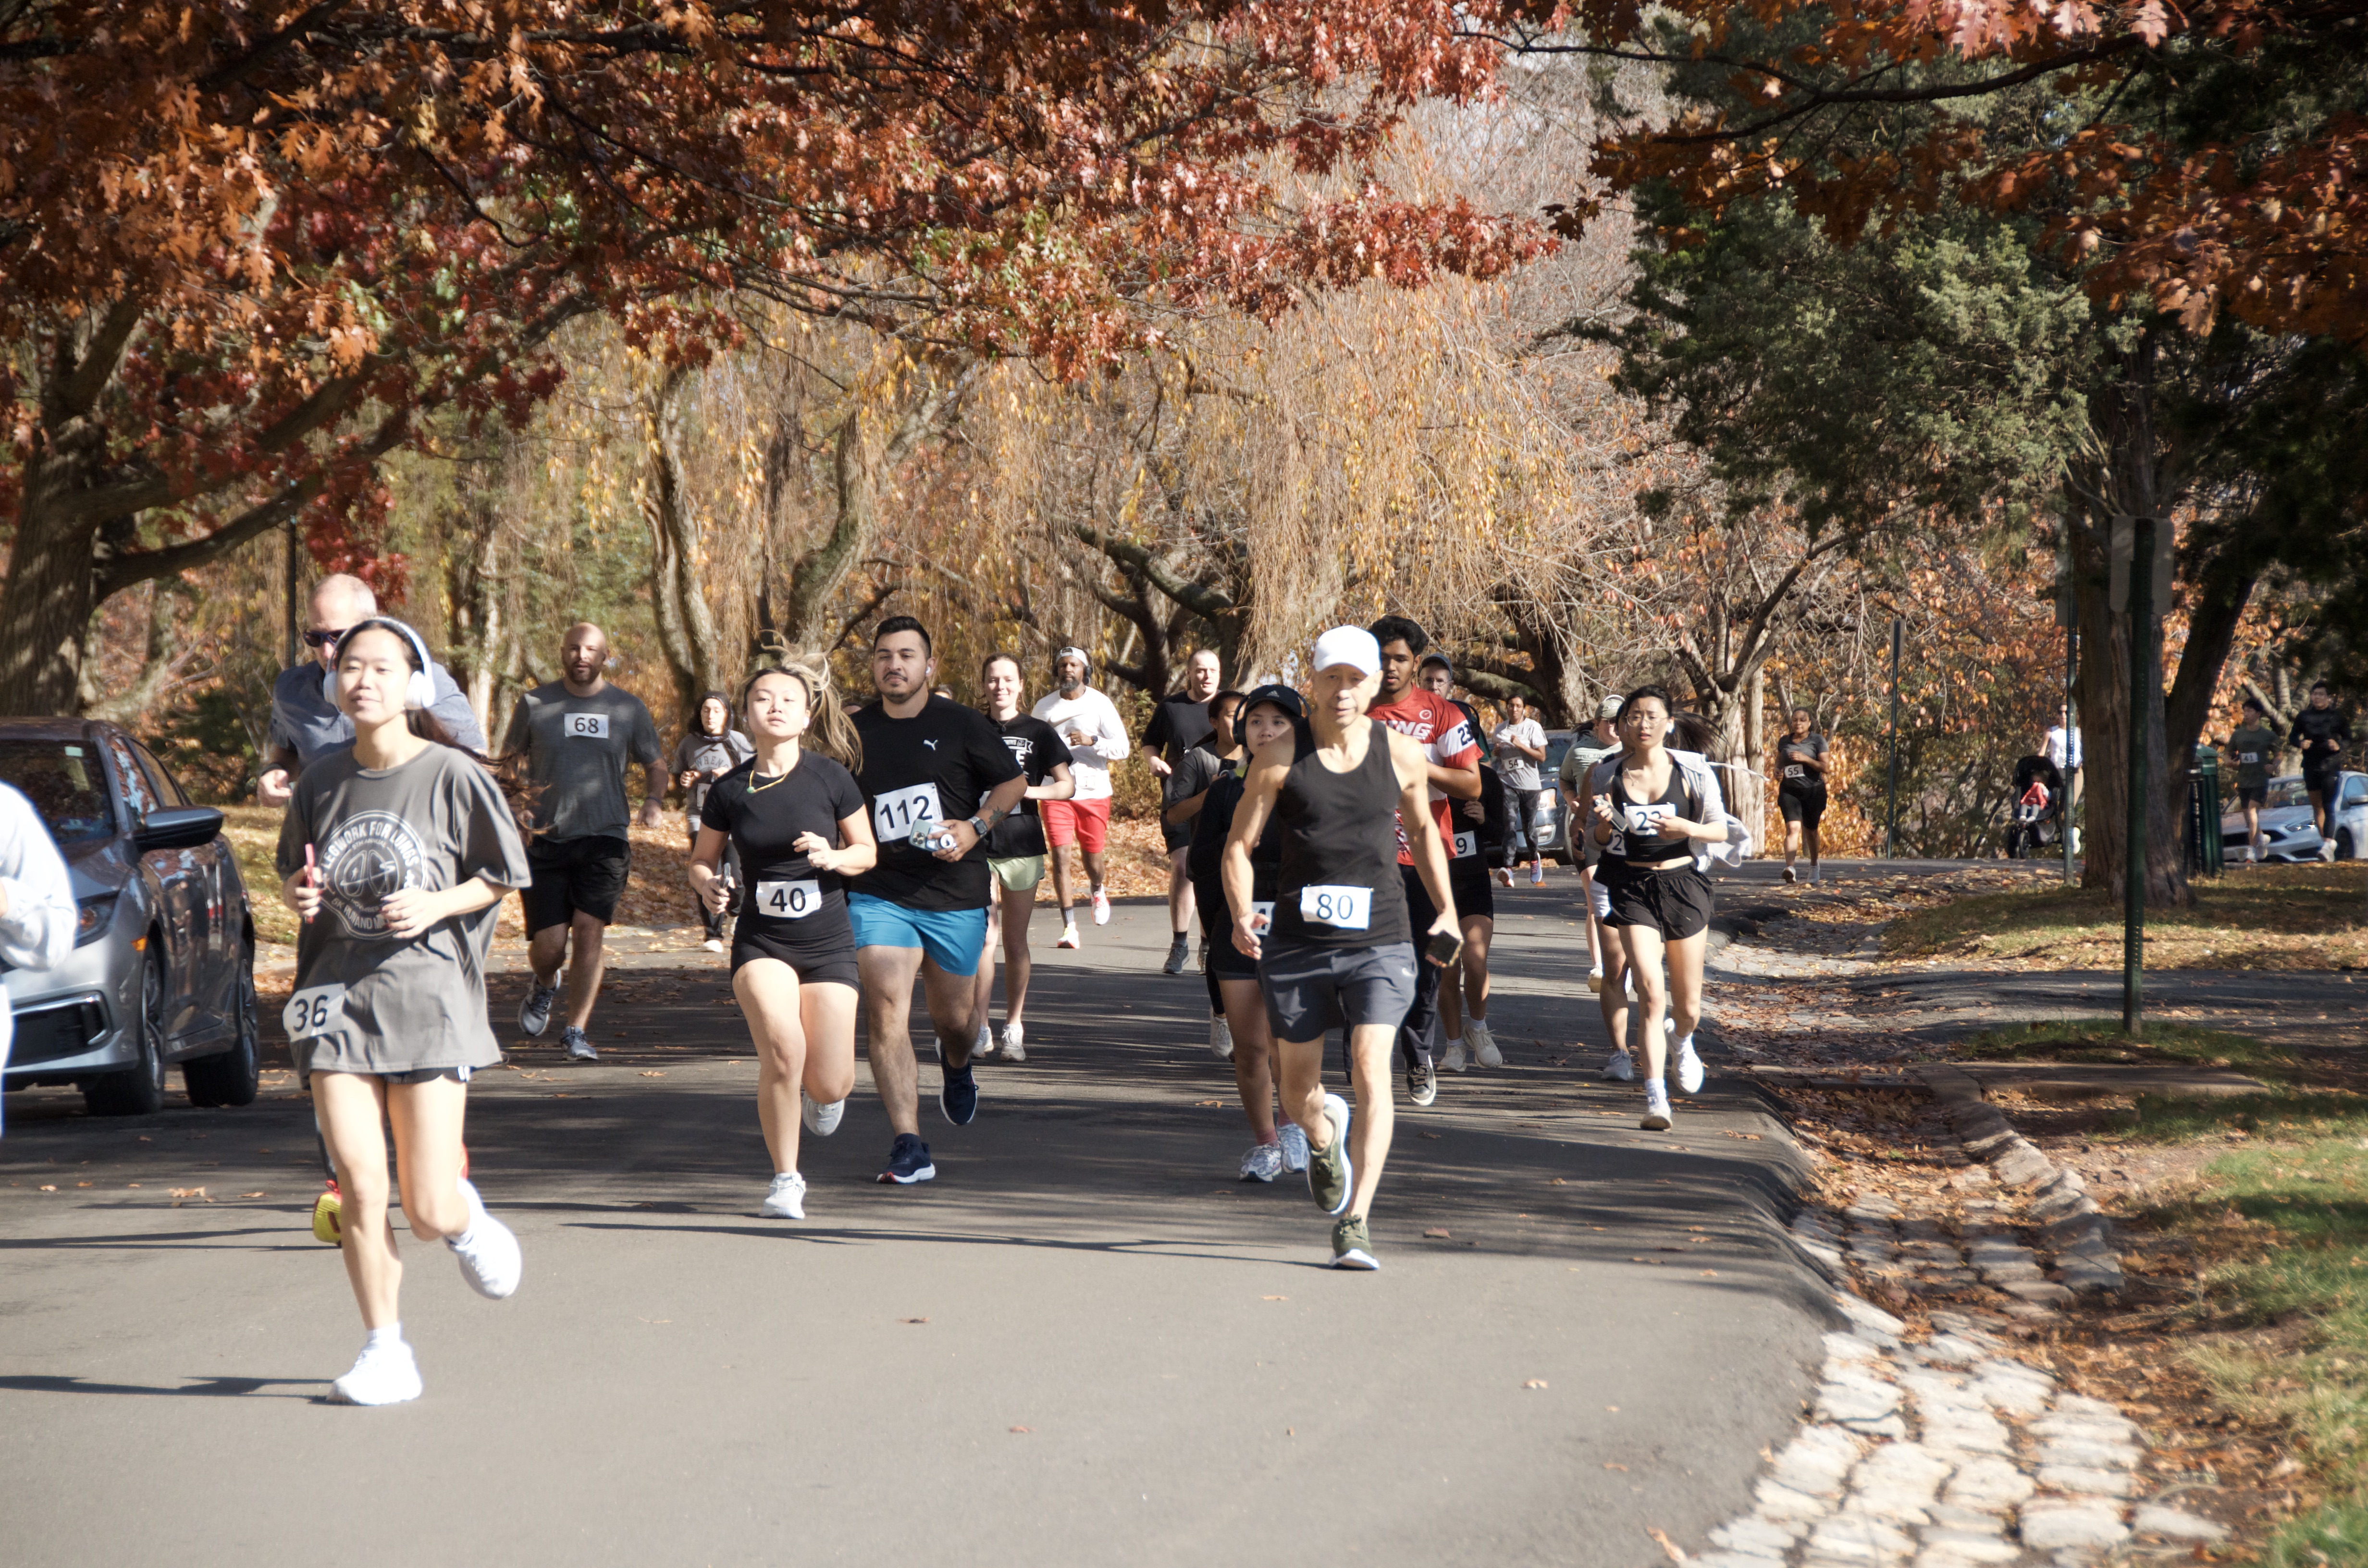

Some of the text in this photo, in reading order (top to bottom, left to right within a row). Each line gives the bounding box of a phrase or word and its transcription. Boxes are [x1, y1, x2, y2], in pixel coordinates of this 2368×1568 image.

[574, 717, 598, 734] 68
[1508, 759, 1518, 769] 54
[1788, 767, 1799, 776] 55
[880, 795, 933, 829] 112
[321, 821, 420, 869] LEGWORK FOR LUNGS
[770, 887, 806, 912] 40
[1316, 894, 1353, 919] 80
[293, 994, 328, 1032] 36
